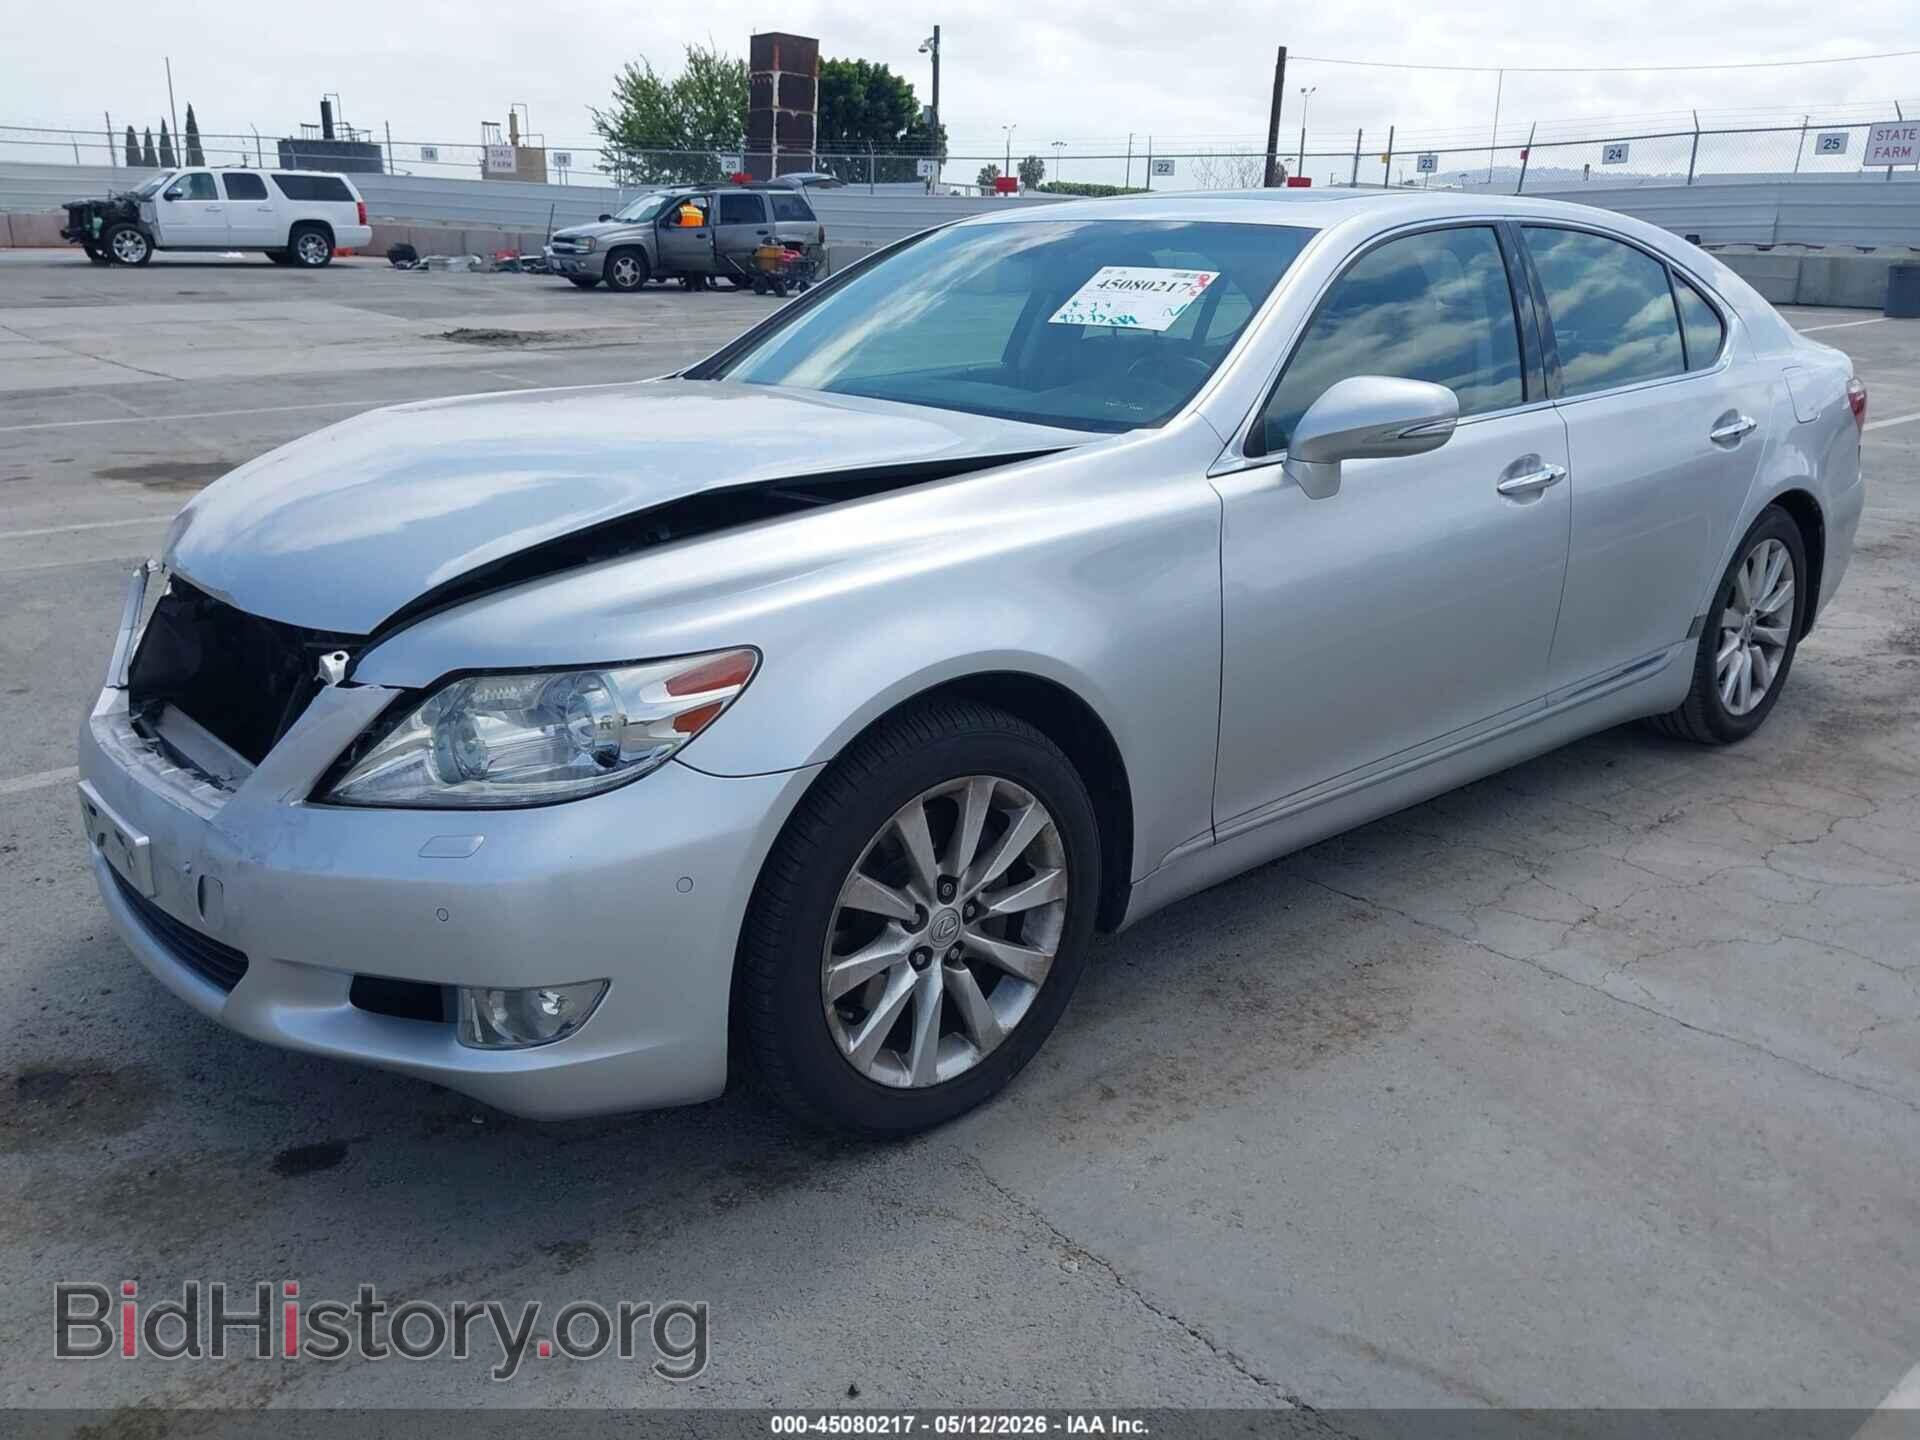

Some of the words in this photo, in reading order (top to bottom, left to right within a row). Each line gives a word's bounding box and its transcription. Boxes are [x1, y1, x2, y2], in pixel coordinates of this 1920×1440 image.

[1875, 128, 1918, 141] STATE
[1823, 138, 1841, 150] 25
[1608, 149, 1623, 160] 24
[1873, 146, 1912, 159] FARM
[726, 160, 737, 169] 20
[923, 164, 934, 173] 21
[1157, 163, 1170, 173] 22
[1422, 159, 1433, 169] 23
[1096, 278, 1192, 294] 45080217
